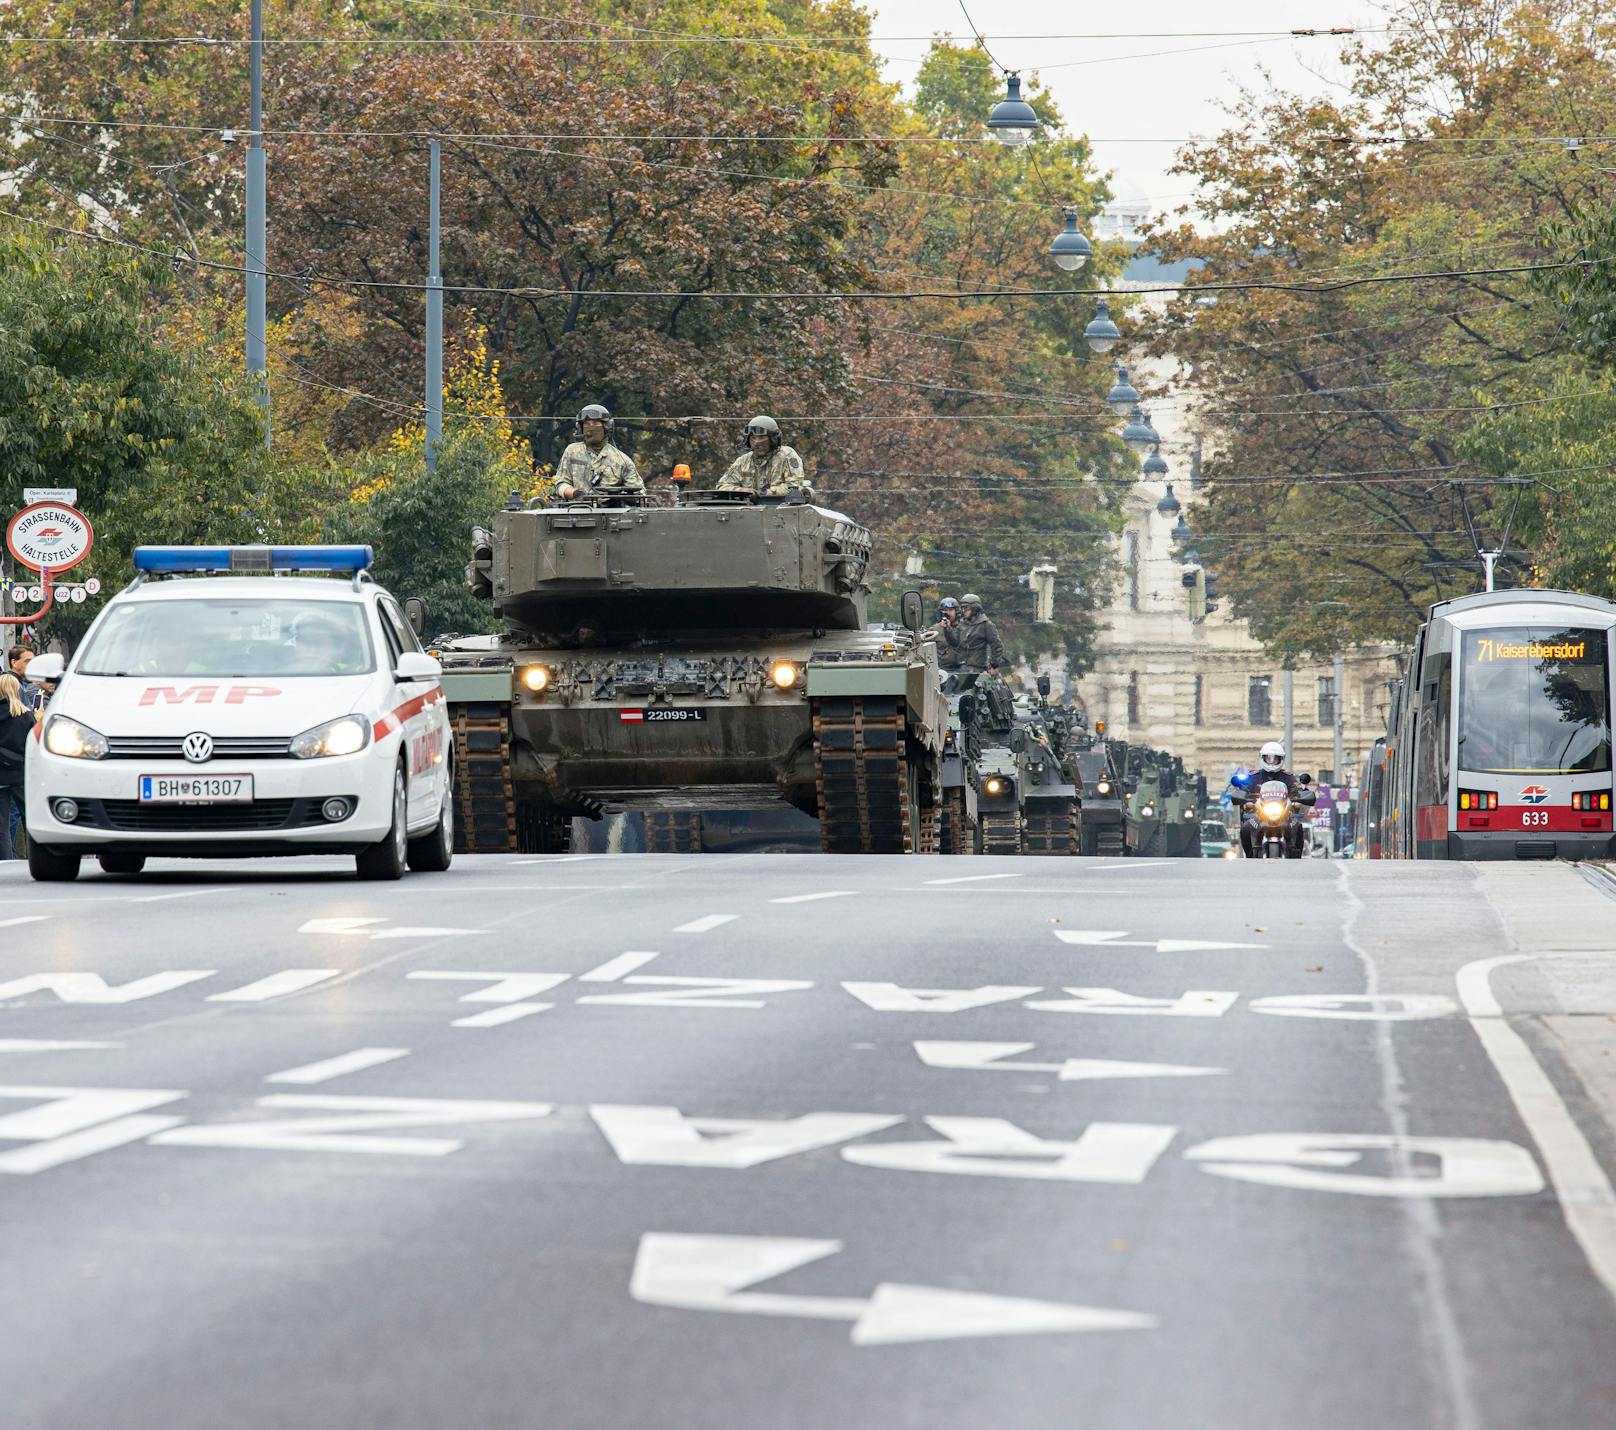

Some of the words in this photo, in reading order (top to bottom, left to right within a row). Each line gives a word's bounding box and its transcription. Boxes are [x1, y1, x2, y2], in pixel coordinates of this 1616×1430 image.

[18, 511, 82, 534] STRASSENBAHN
[21, 543, 79, 562] HALTESTELLE
[89, 582, 96, 590] D
[15, 591, 26, 599] 71
[32, 590, 39, 599] 2
[1478, 640, 1493, 661] 71
[1496, 642, 1585, 659] Kaiserebersdorf
[138, 686, 283, 706] MP
[647, 710, 702, 721] 22099-L
[158, 780, 179, 797] BH
[192, 780, 242, 797] 61307
[1522, 811, 1549, 826] 633
